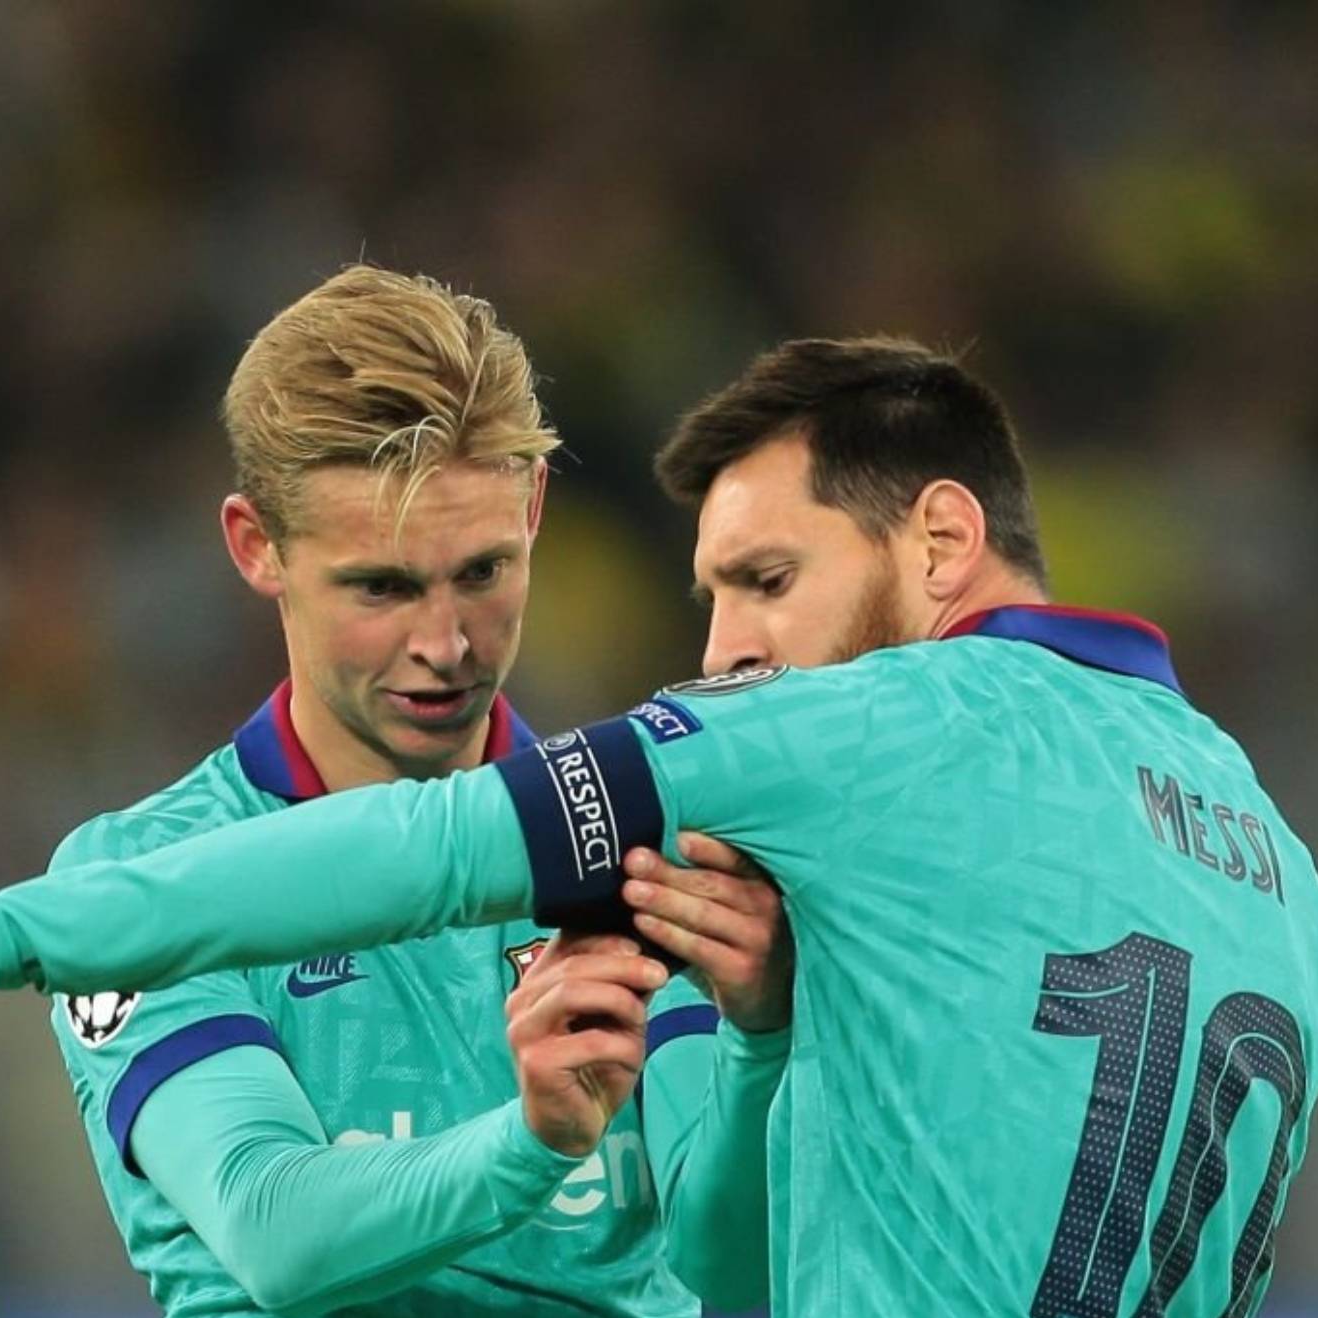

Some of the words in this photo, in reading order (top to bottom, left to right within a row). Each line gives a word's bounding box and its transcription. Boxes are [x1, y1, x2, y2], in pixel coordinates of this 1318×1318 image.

[556, 752, 612, 871] RESPECT
[1137, 766, 1285, 907] MESSI
[299, 954, 356, 978] NIKE
